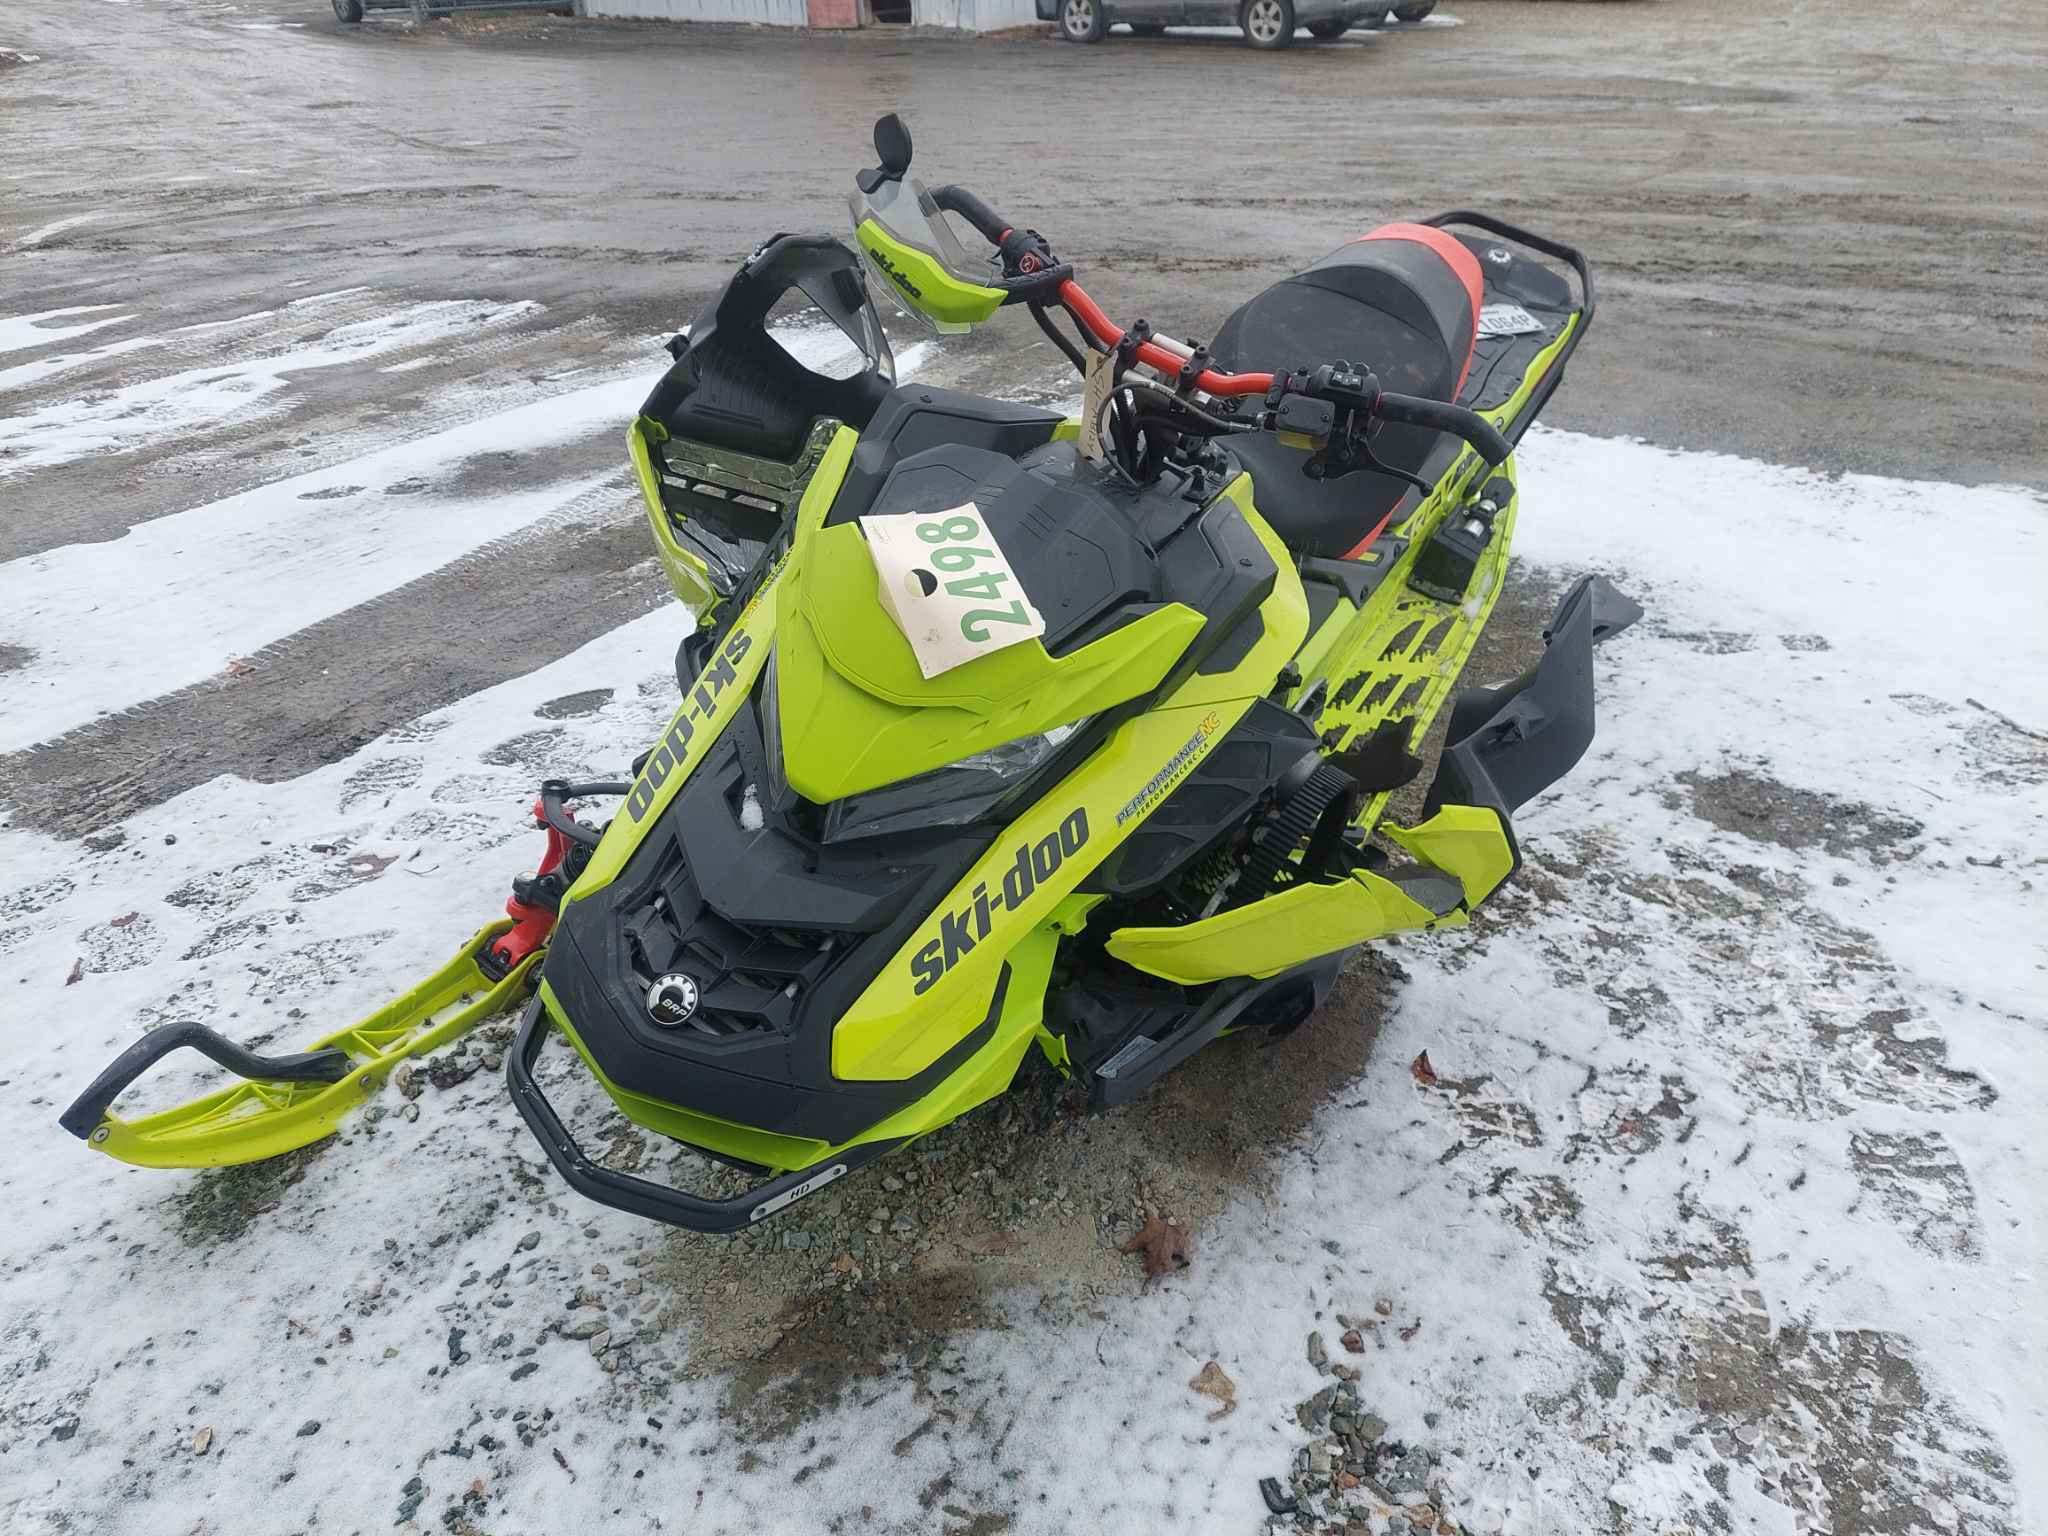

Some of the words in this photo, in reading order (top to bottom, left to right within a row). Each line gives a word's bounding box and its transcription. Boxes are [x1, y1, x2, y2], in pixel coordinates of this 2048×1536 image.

[915, 515, 1033, 643] 2498
[626, 628, 753, 824] ski-doo
[910, 806, 1090, 997] ski-doo
[662, 998, 688, 1016] BRP
[790, 1183, 811, 1200] HD
